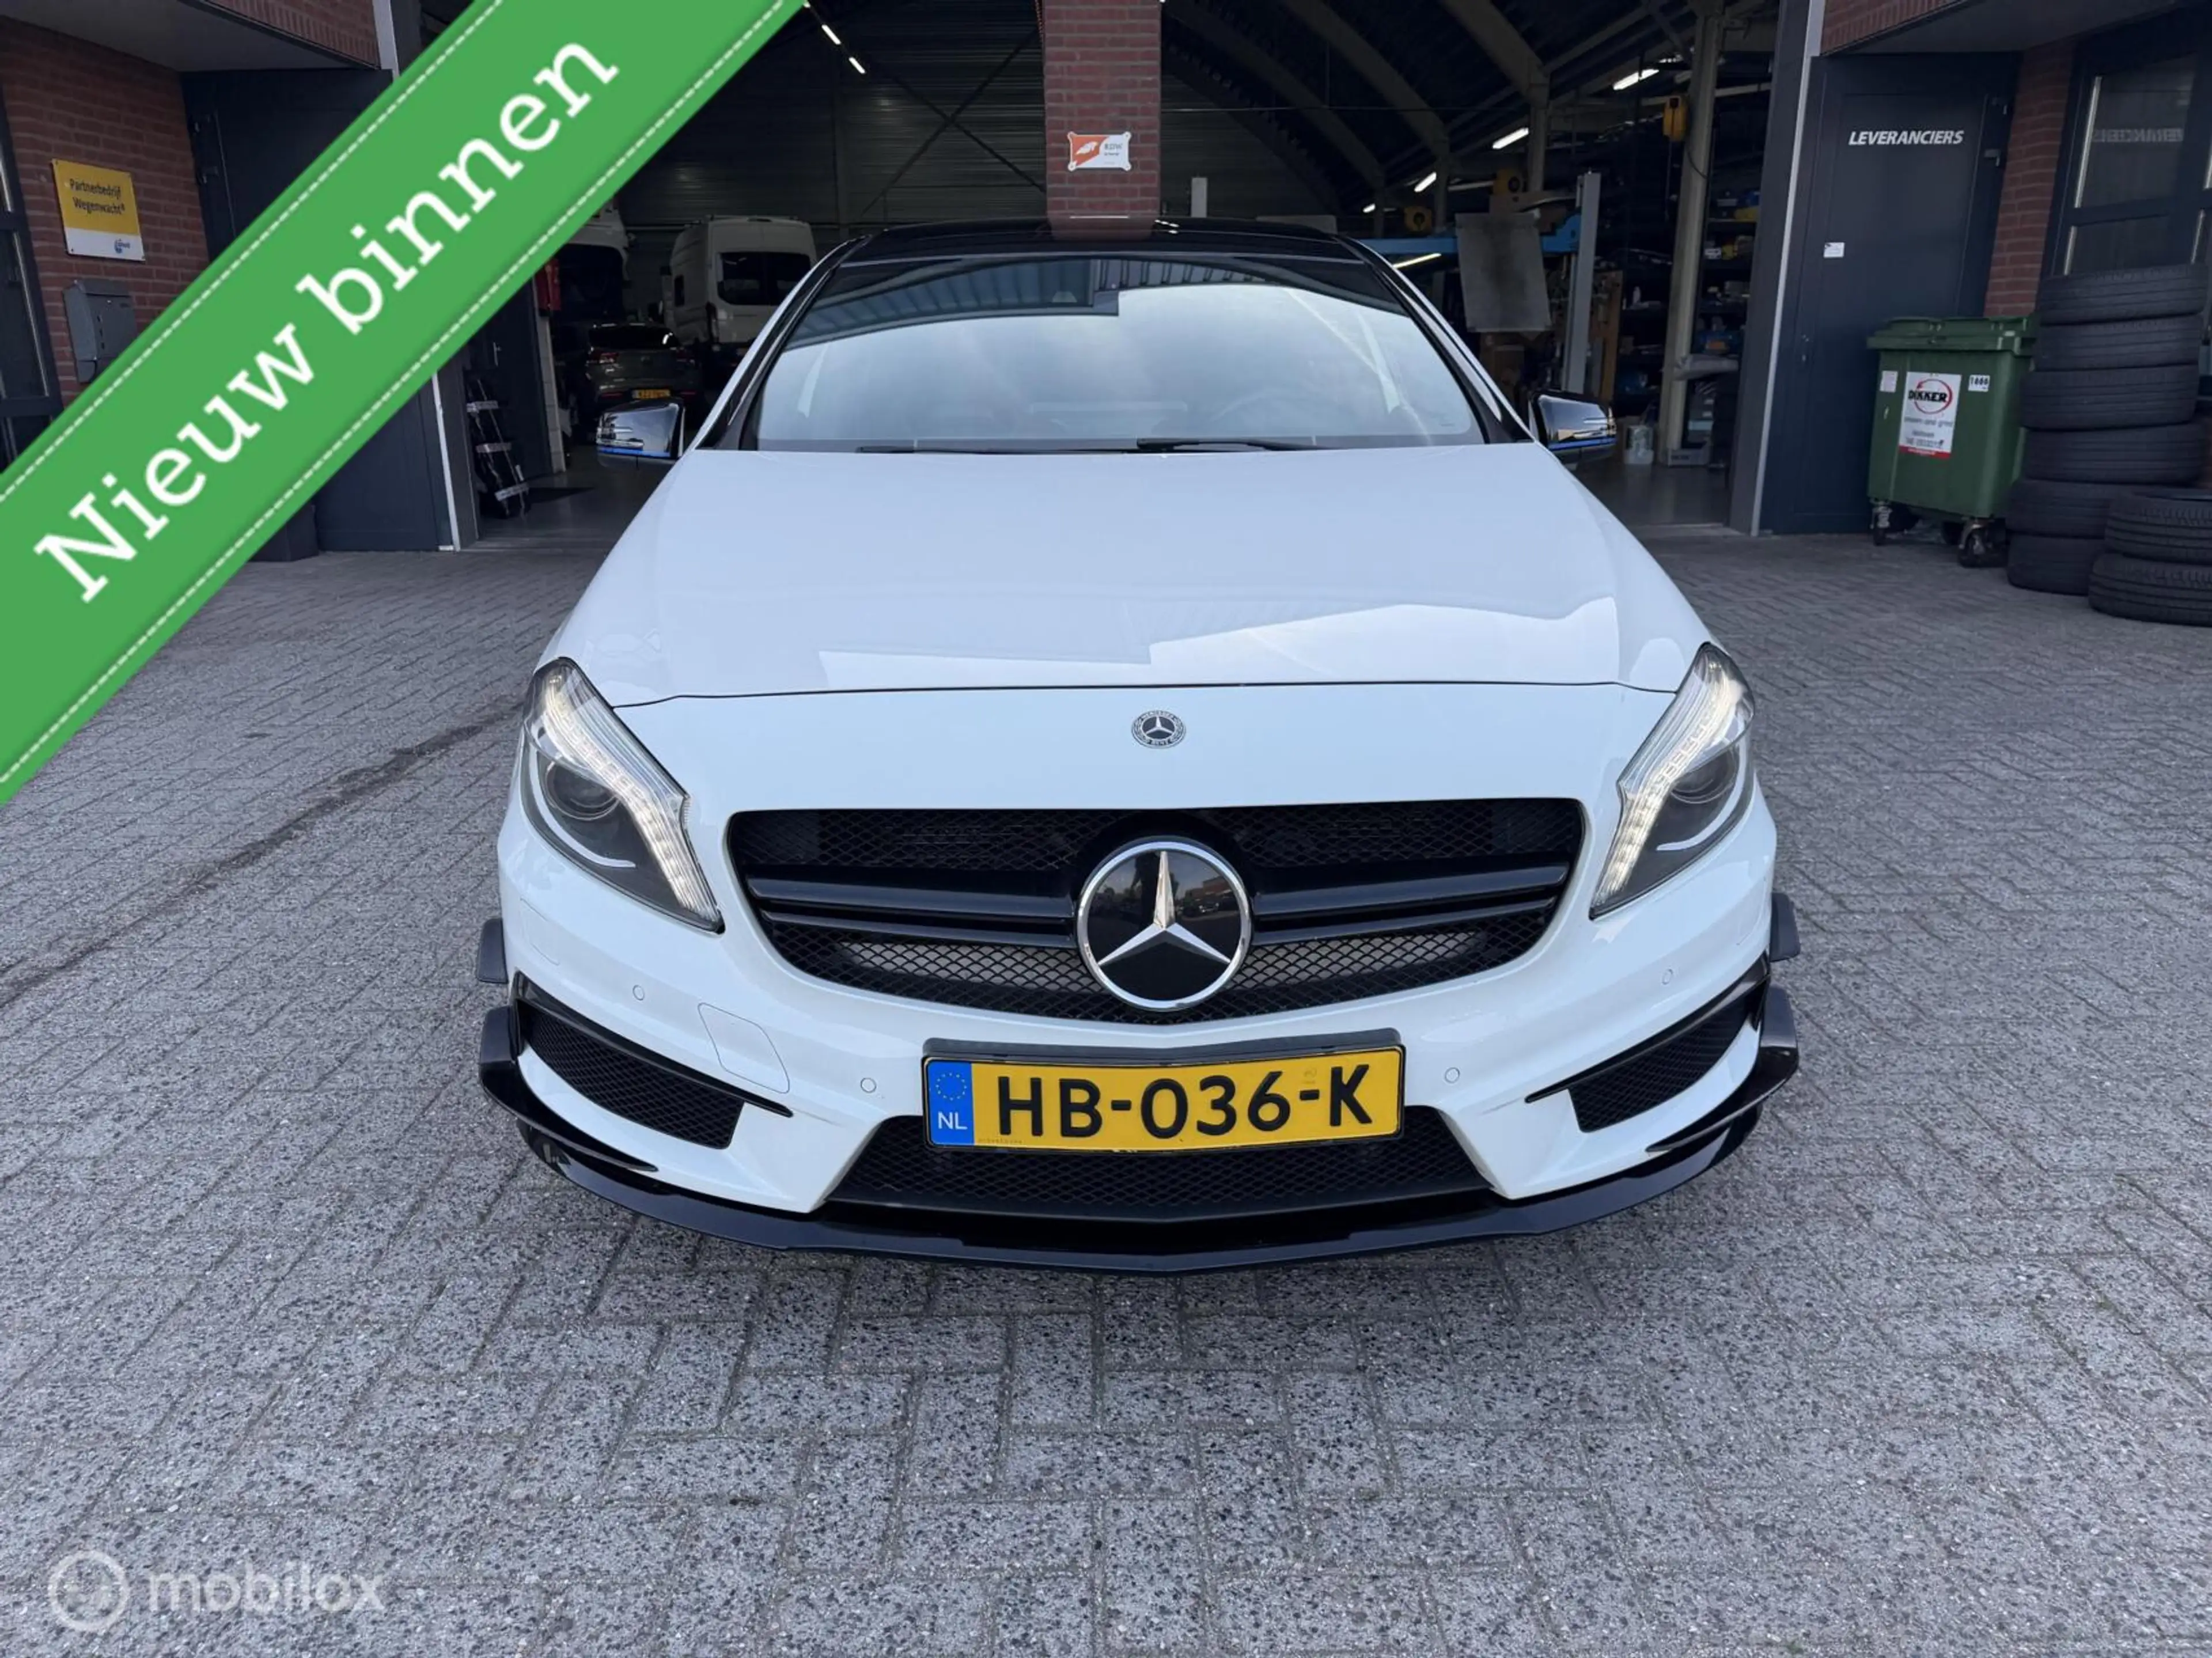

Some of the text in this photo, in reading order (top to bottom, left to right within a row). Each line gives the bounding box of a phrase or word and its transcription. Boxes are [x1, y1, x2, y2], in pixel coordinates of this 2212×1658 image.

[1849, 130, 1964, 145] LEVERANCIERS
[70, 178, 121, 200] Partnerbedrijf
[998, 1064, 1373, 1139] HB-036-K
[937, 1111, 968, 1131] NL
